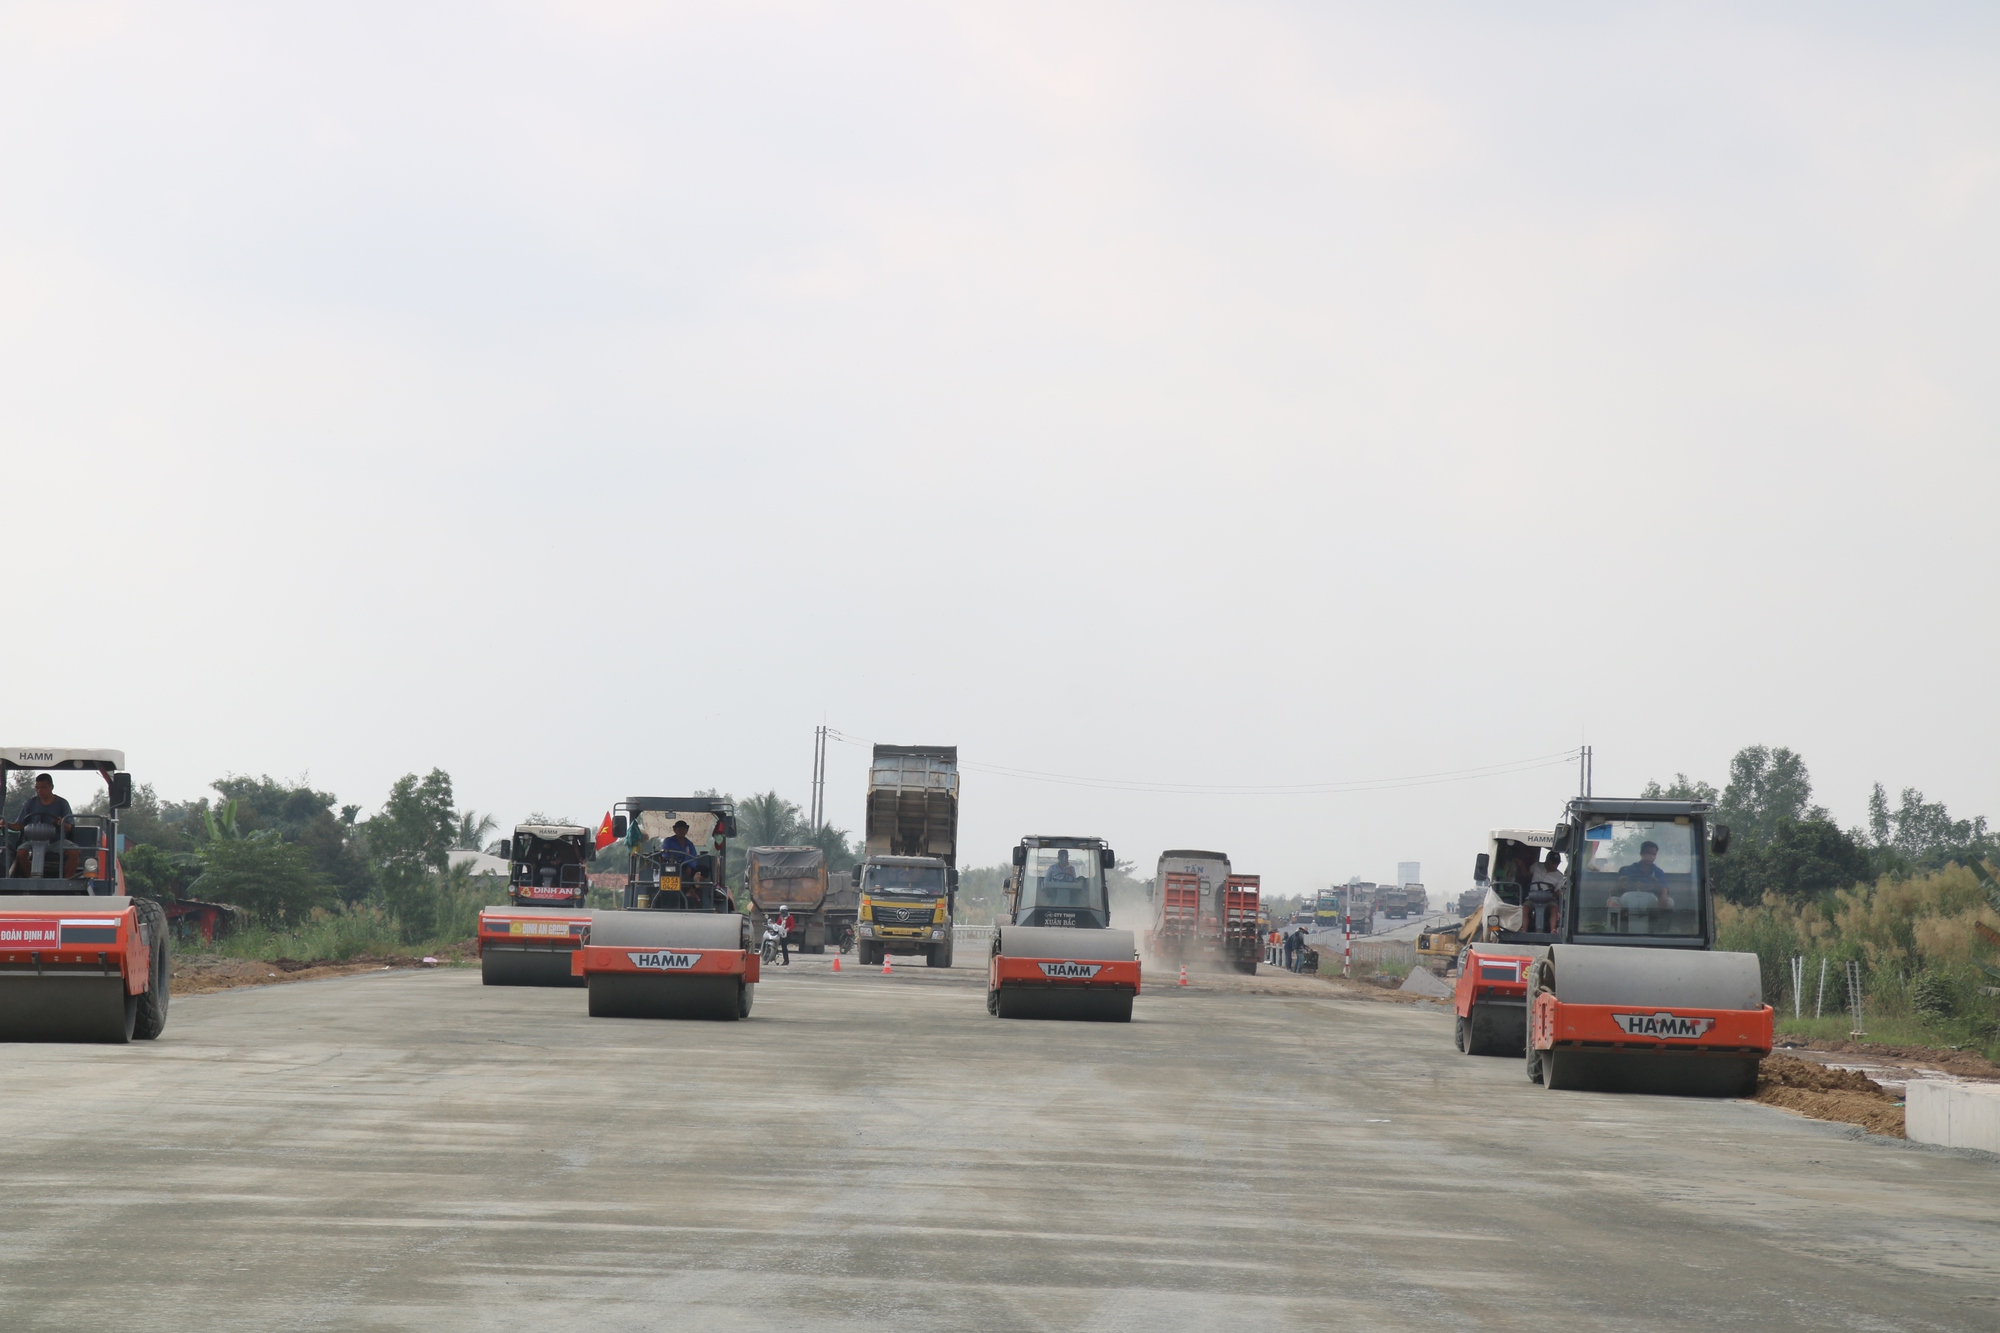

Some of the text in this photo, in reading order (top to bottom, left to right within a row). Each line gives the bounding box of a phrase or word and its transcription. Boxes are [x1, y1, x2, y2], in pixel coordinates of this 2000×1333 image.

[19, 752, 53, 761] HAMM
[1, 928, 56, 943] ĐOÀN ĐỊNH AN
[538, 924, 548, 935] AN
[548, 924, 569, 936] GROUP
[639, 954, 689, 967] HAMM
[1047, 964, 1091, 977] HAMM
[1629, 1017, 1697, 1035] HAMM
